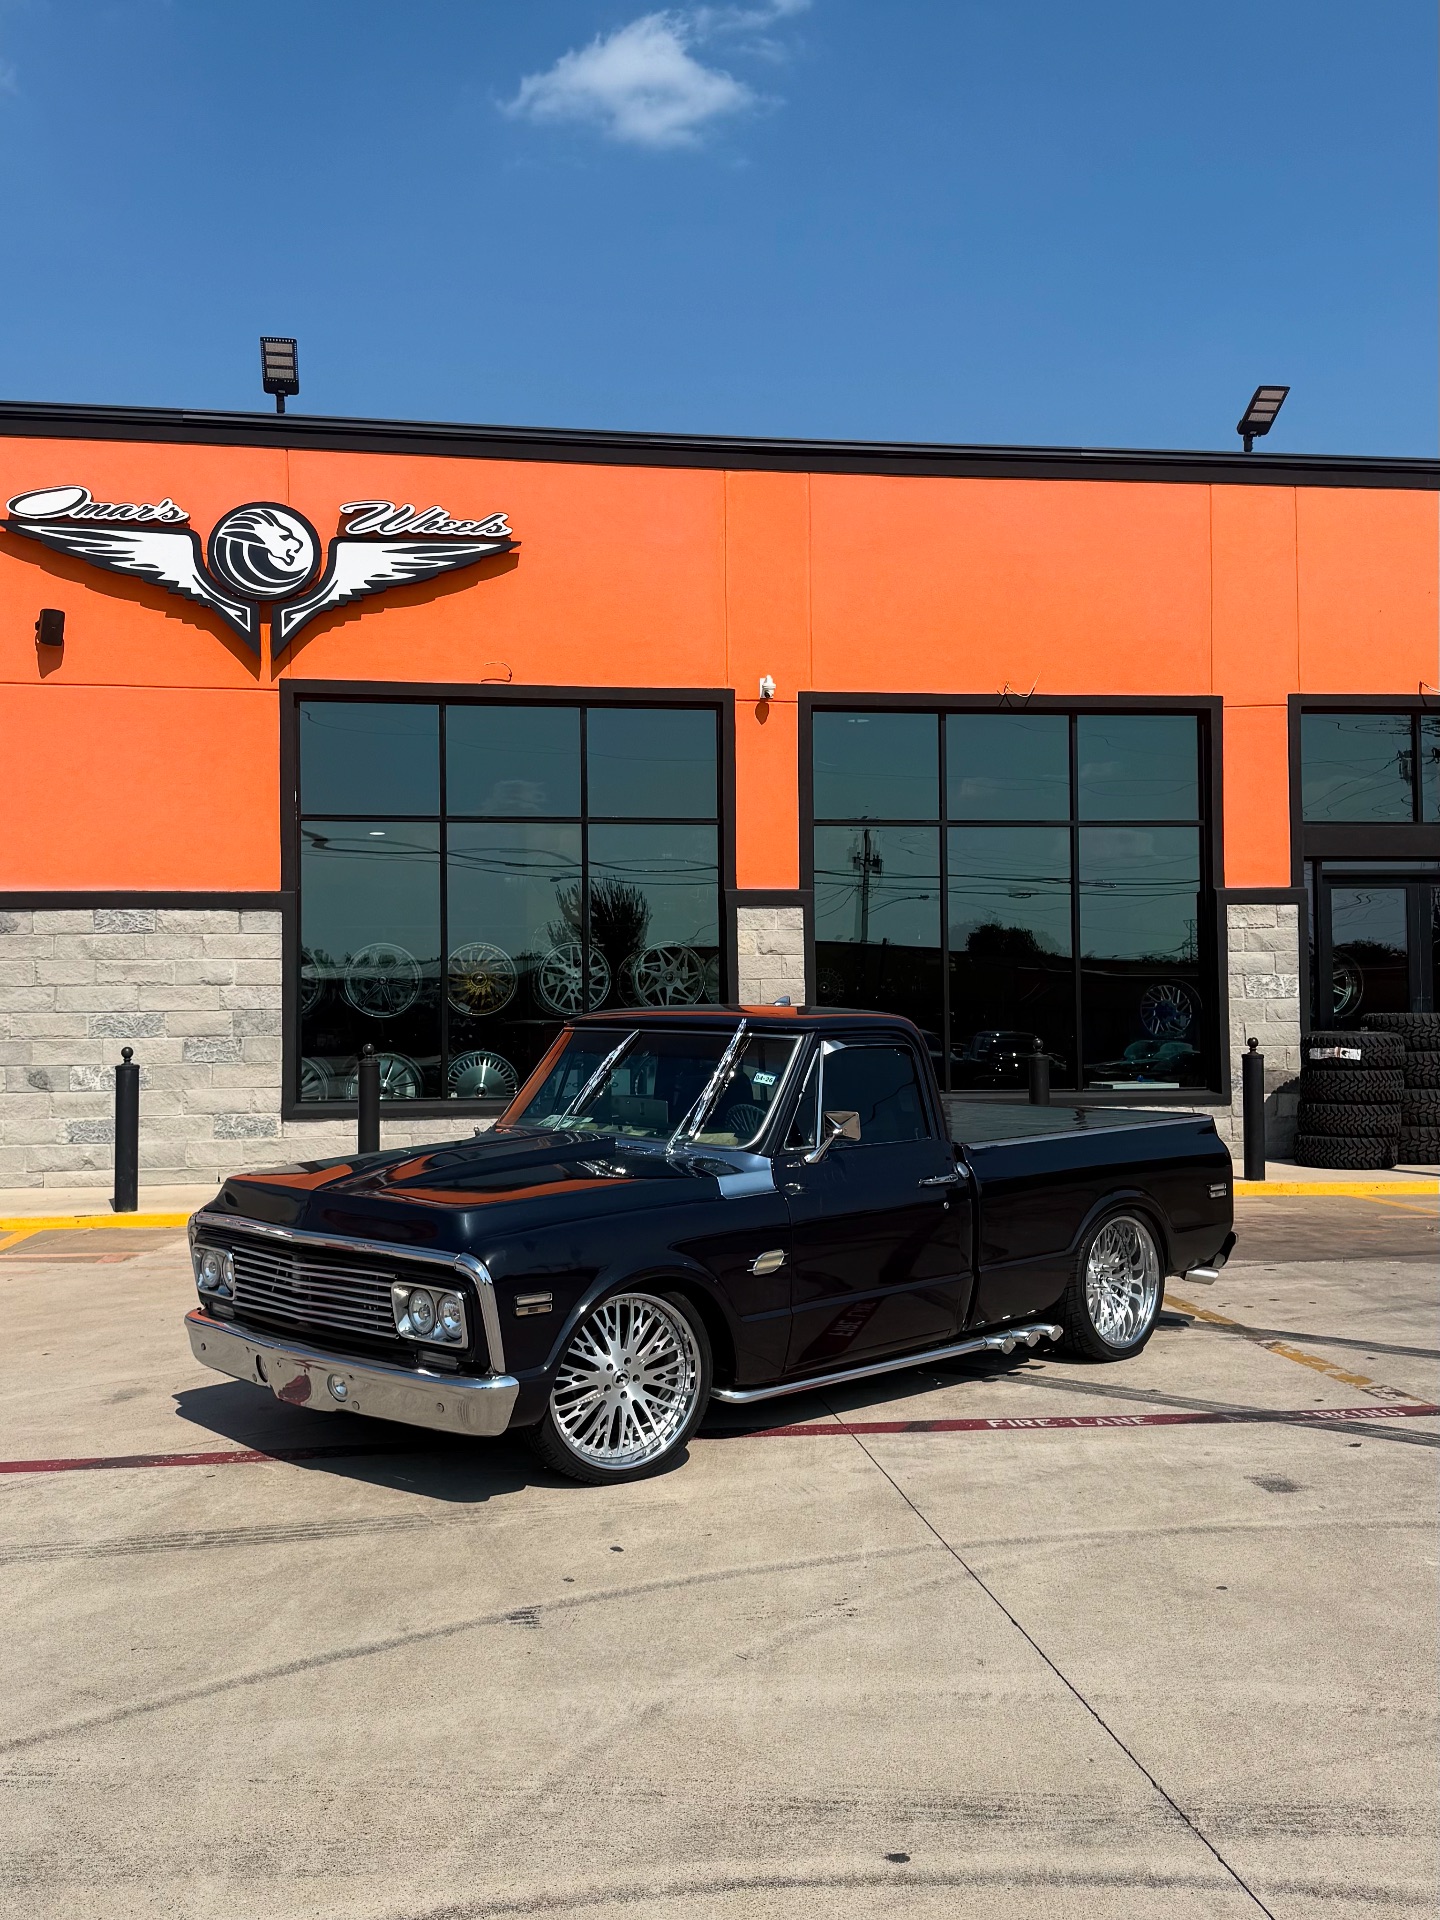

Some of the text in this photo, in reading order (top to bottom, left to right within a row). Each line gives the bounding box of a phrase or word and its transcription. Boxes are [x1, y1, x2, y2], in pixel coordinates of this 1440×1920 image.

[6, 485, 513, 537] Omar's Wheels
[1292, 1408, 1406, 1420] RKING
[986, 1415, 1153, 1428] FIRE LANE
